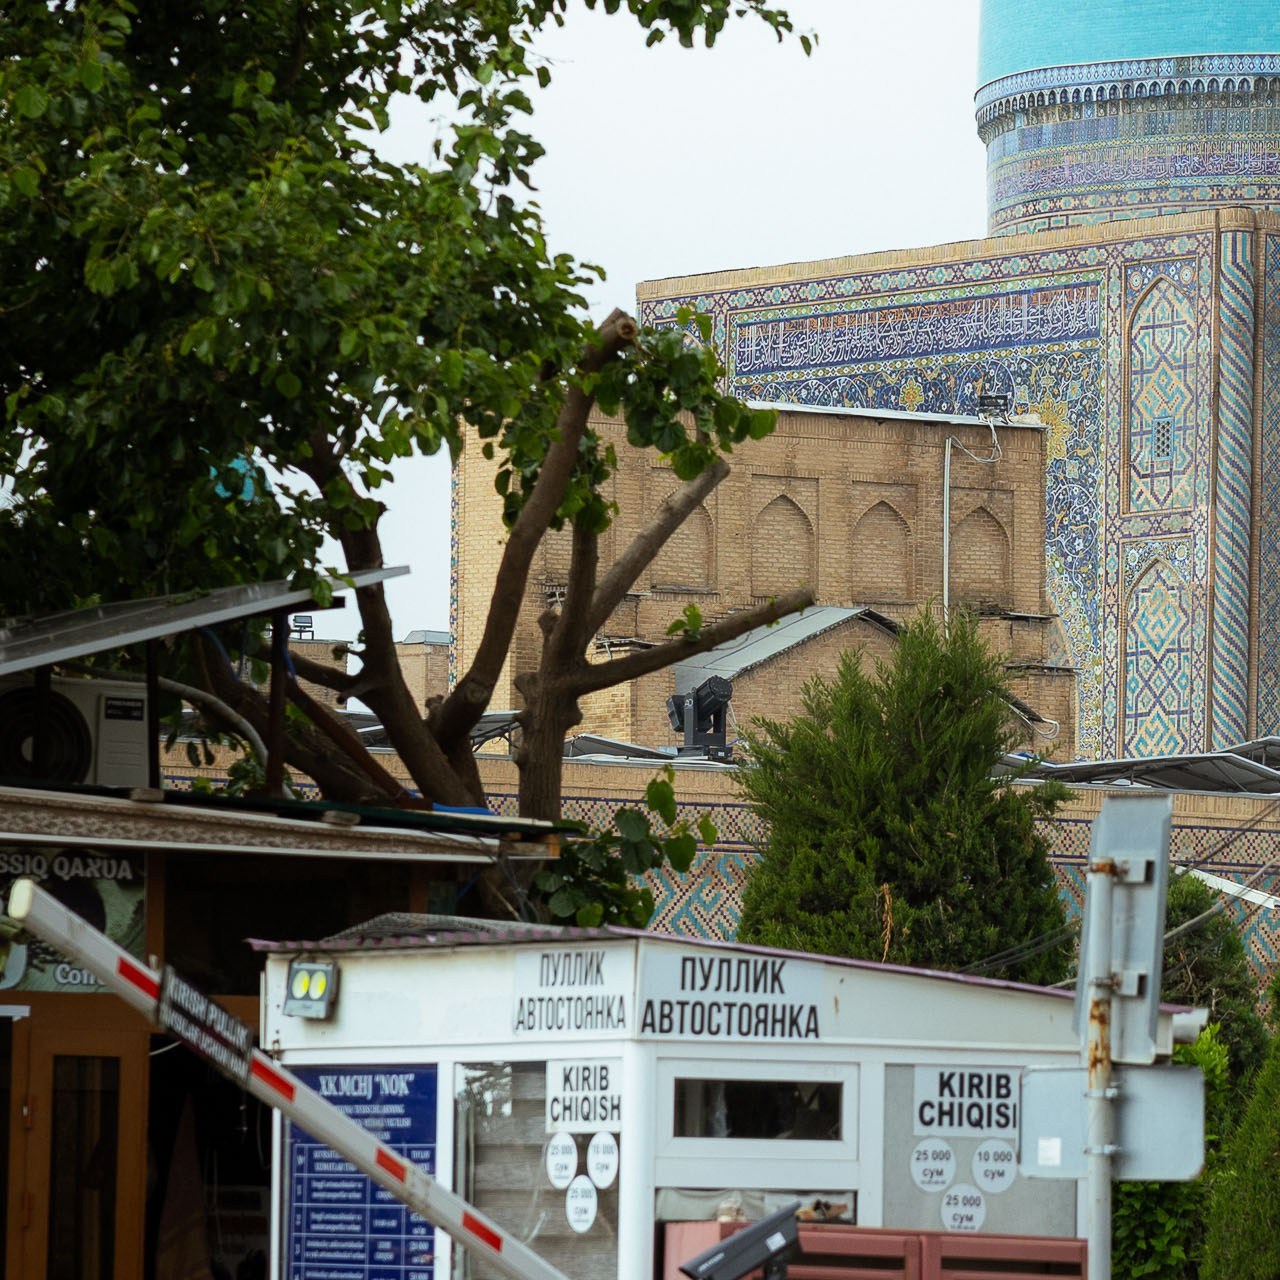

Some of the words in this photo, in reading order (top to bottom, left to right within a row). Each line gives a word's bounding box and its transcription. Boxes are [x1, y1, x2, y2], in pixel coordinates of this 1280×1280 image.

[539, 951, 605, 987] ПУЛЛИК
[680, 956, 787, 995] ПУЛЛИК
[515, 995, 626, 1032] АВТОСТОЯНКА
[640, 998, 820, 1039] АВТОСТОЯНКА
[562, 1065, 610, 1092] KIRIB
[938, 1071, 1012, 1100] KIRIB
[550, 1094, 621, 1123] CHIQISH
[915, 1149, 928, 1161] 25
[931, 1150, 951, 1161] 000
[977, 1150, 990, 1162] 10
[993, 1151, 1013, 1162] 000
[945, 1194, 959, 1206] 25
[962, 1195, 982, 1207] 000
